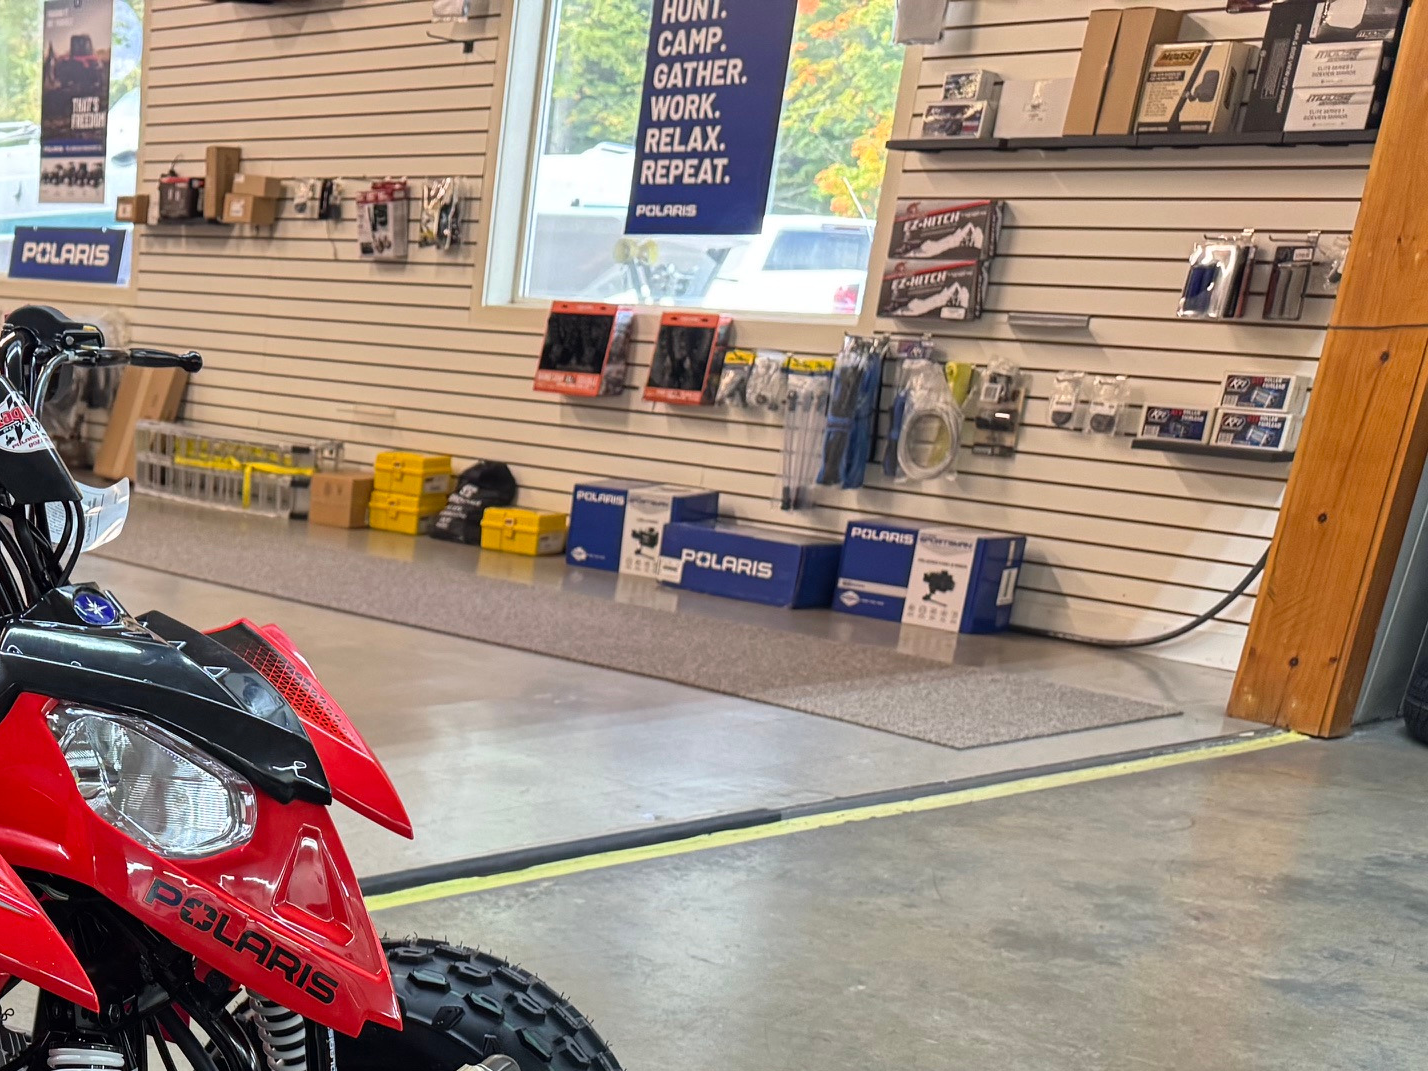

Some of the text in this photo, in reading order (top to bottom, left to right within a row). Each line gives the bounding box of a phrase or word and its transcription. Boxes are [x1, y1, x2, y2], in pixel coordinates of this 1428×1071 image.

[661, 0, 727, 25] HUNT.
[657, 26, 727, 57] CAMP.
[653, 58, 748, 89] GATHER.
[650, 93, 721, 121] WORK.
[71, 112, 107, 130] FREEDOM
[644, 125, 726, 153] RELAX.
[640, 158, 730, 185] REPEAT.
[635, 204, 697, 218] POLARIS
[22, 242, 110, 267] POLARIS
[576, 490, 624, 506] POLARIS
[851, 526, 915, 546] POLARIS
[681, 548, 773, 580] POLARIS
[143, 878, 339, 1005] POLARIS
